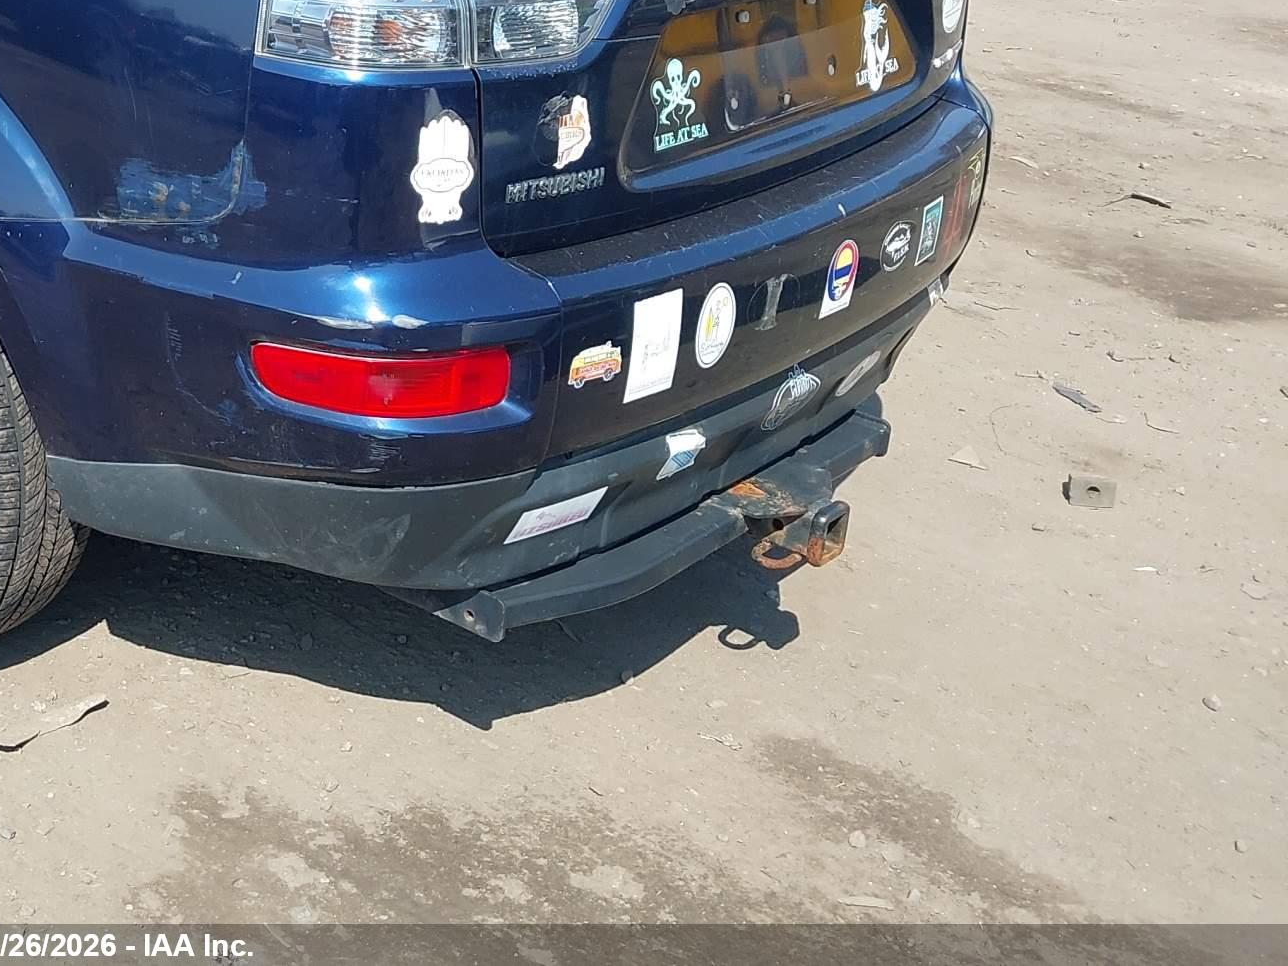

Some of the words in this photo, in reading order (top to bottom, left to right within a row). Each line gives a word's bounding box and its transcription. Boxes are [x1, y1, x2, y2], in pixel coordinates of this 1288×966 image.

[655, 131, 676, 151] LIFE
[676, 126, 690, 143] AT
[690, 122, 710, 139] SEA
[505, 167, 605, 204] MITSUBISHI
